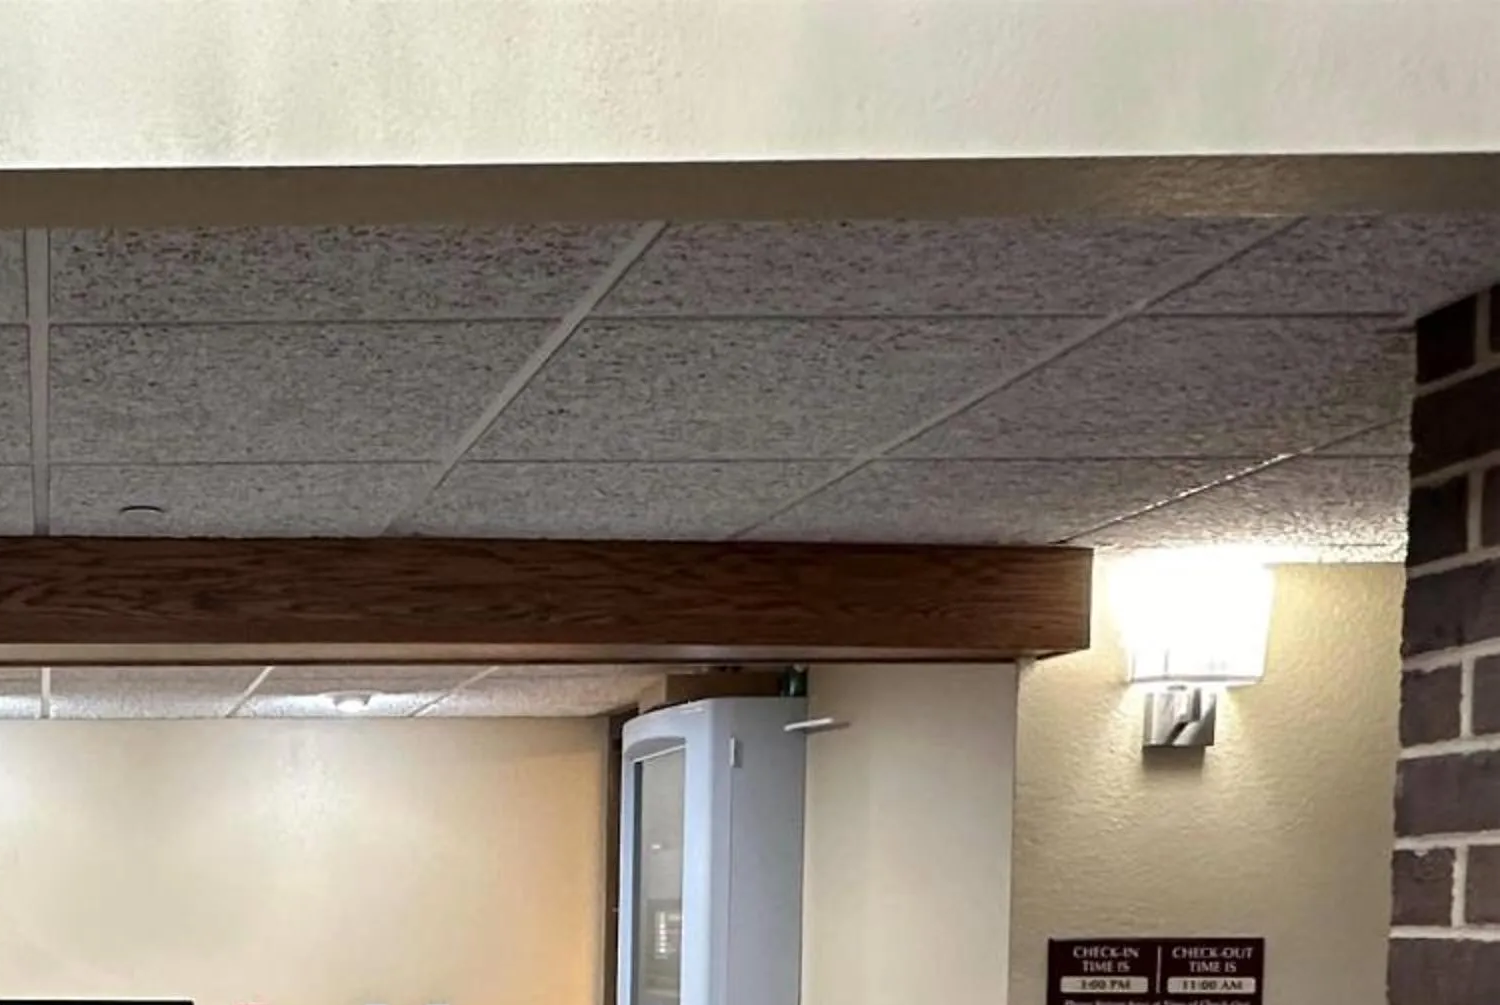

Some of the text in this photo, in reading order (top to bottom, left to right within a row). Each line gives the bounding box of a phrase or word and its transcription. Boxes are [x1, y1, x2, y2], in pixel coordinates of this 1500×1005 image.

[1072, 946, 1140, 960] CHECK-IN
[1172, 946, 1254, 960] CHECK-OUT
[1082, 960, 1131, 973] TIME IS
[1188, 960, 1237, 973] TIME IS
